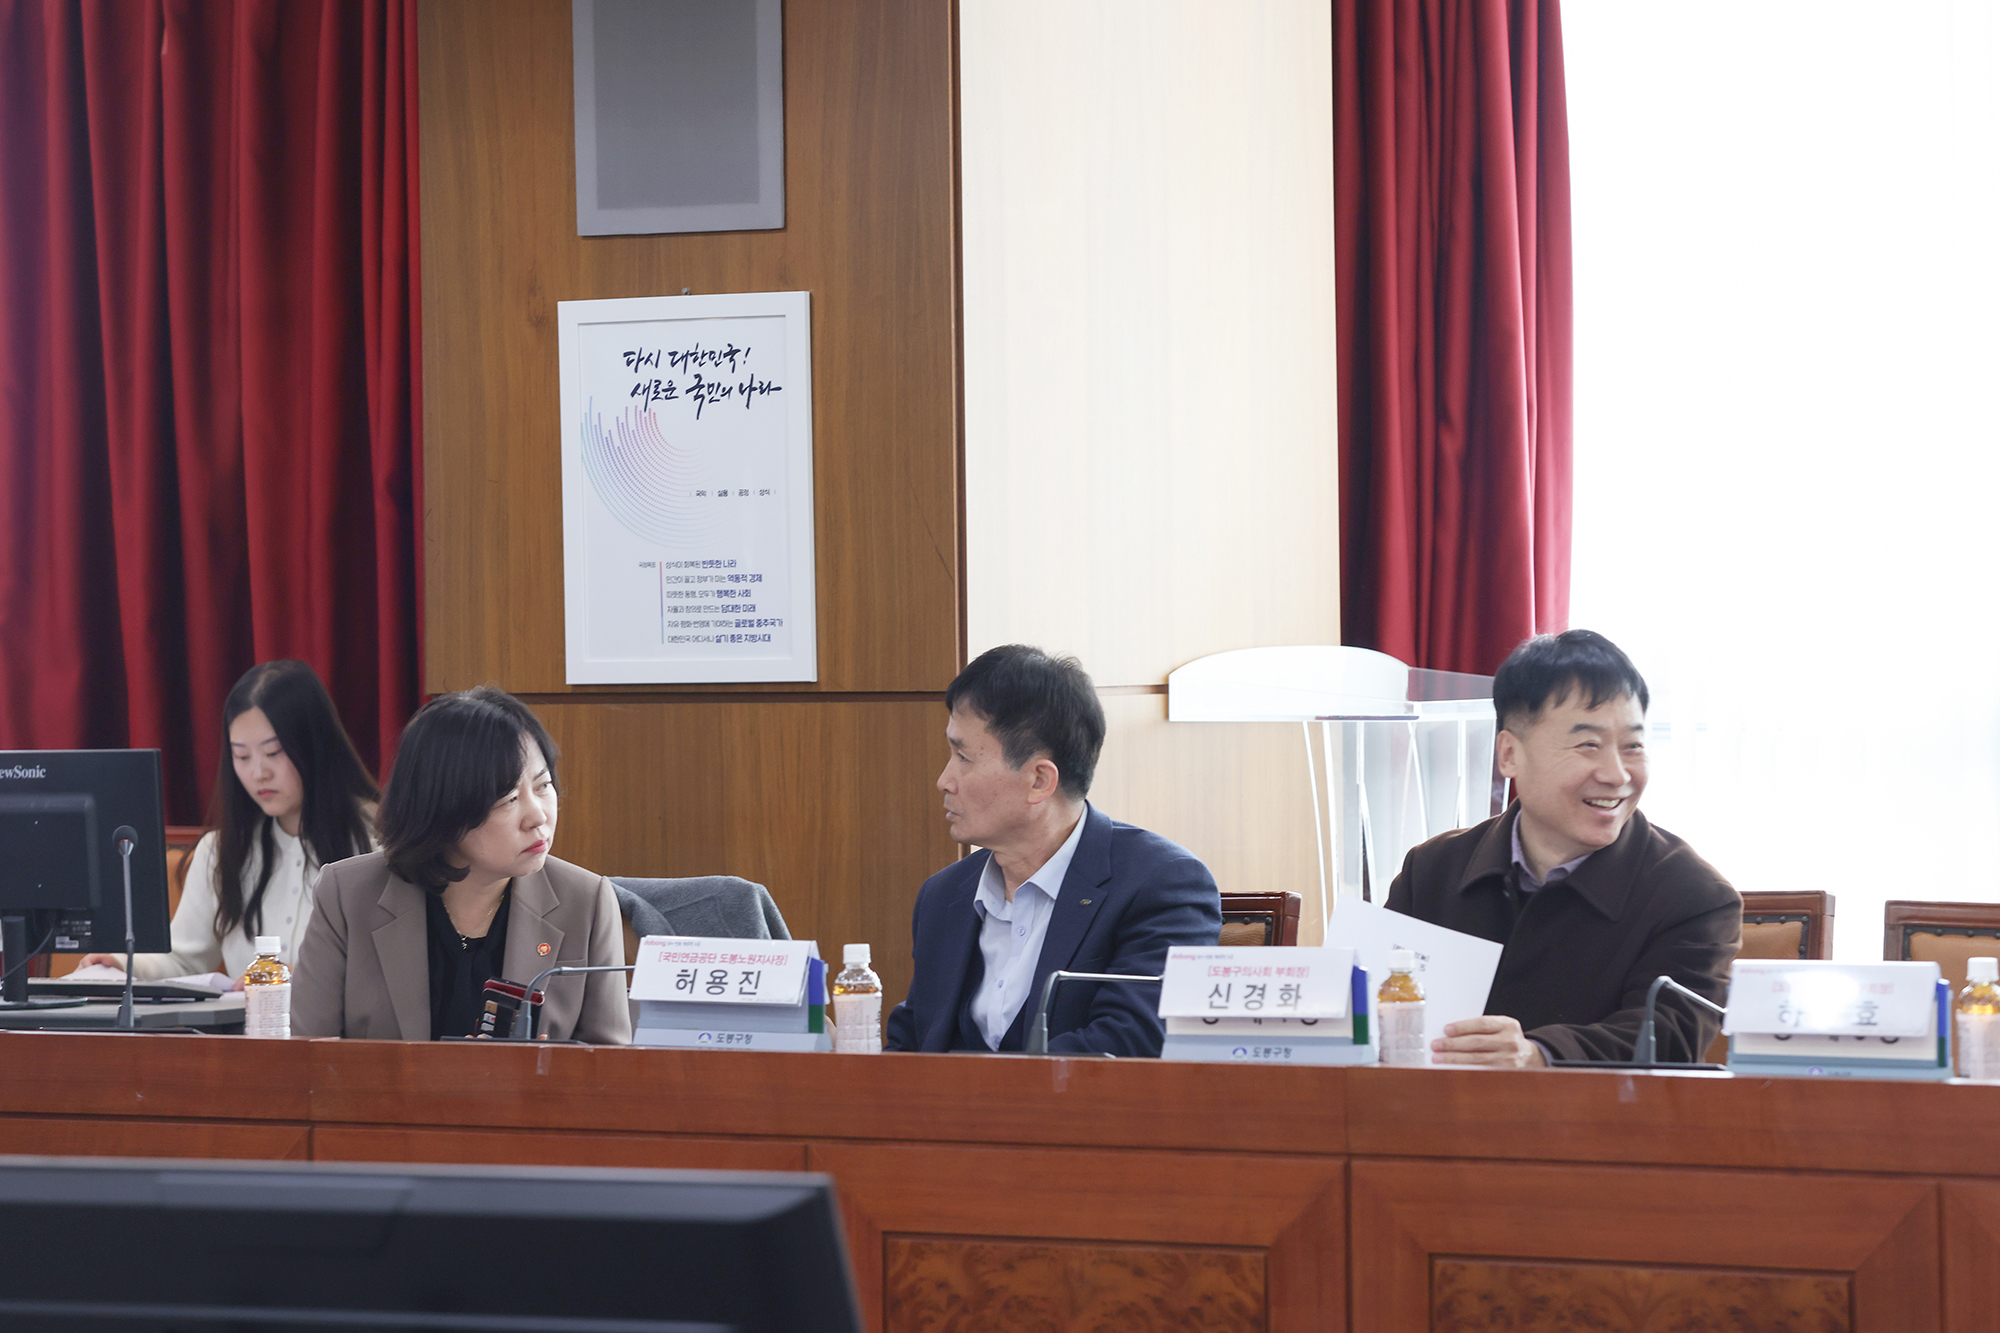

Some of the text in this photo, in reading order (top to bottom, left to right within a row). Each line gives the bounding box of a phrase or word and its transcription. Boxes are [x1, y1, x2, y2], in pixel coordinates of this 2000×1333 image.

[623, 342, 751, 375] 다시 대한민국!
[630, 373, 782, 420] 새로운 국민의 나라
[723, 559, 737, 569] 나라
[727, 573, 748, 583] 역동적
[749, 573, 763, 583] 경제
[716, 589, 737, 599] 행복한
[737, 589, 751, 598] 사회
[742, 604, 756, 613] 미래
[734, 618, 755, 628] 글로벌
[756, 618, 783, 628] 중추국가
[715, 633, 729, 643] 살기
[729, 633, 743, 643] 좋은
[744, 633, 771, 643] 지방시대
[658, 951, 788, 966] [국민연금공단 도봉노원지사장]
[1208, 965, 1310, 978] [도봉구의사회 부회장]
[716, 1033, 753, 1045] 도봉구청
[1252, 1046, 1292, 1059] 도봉구청
